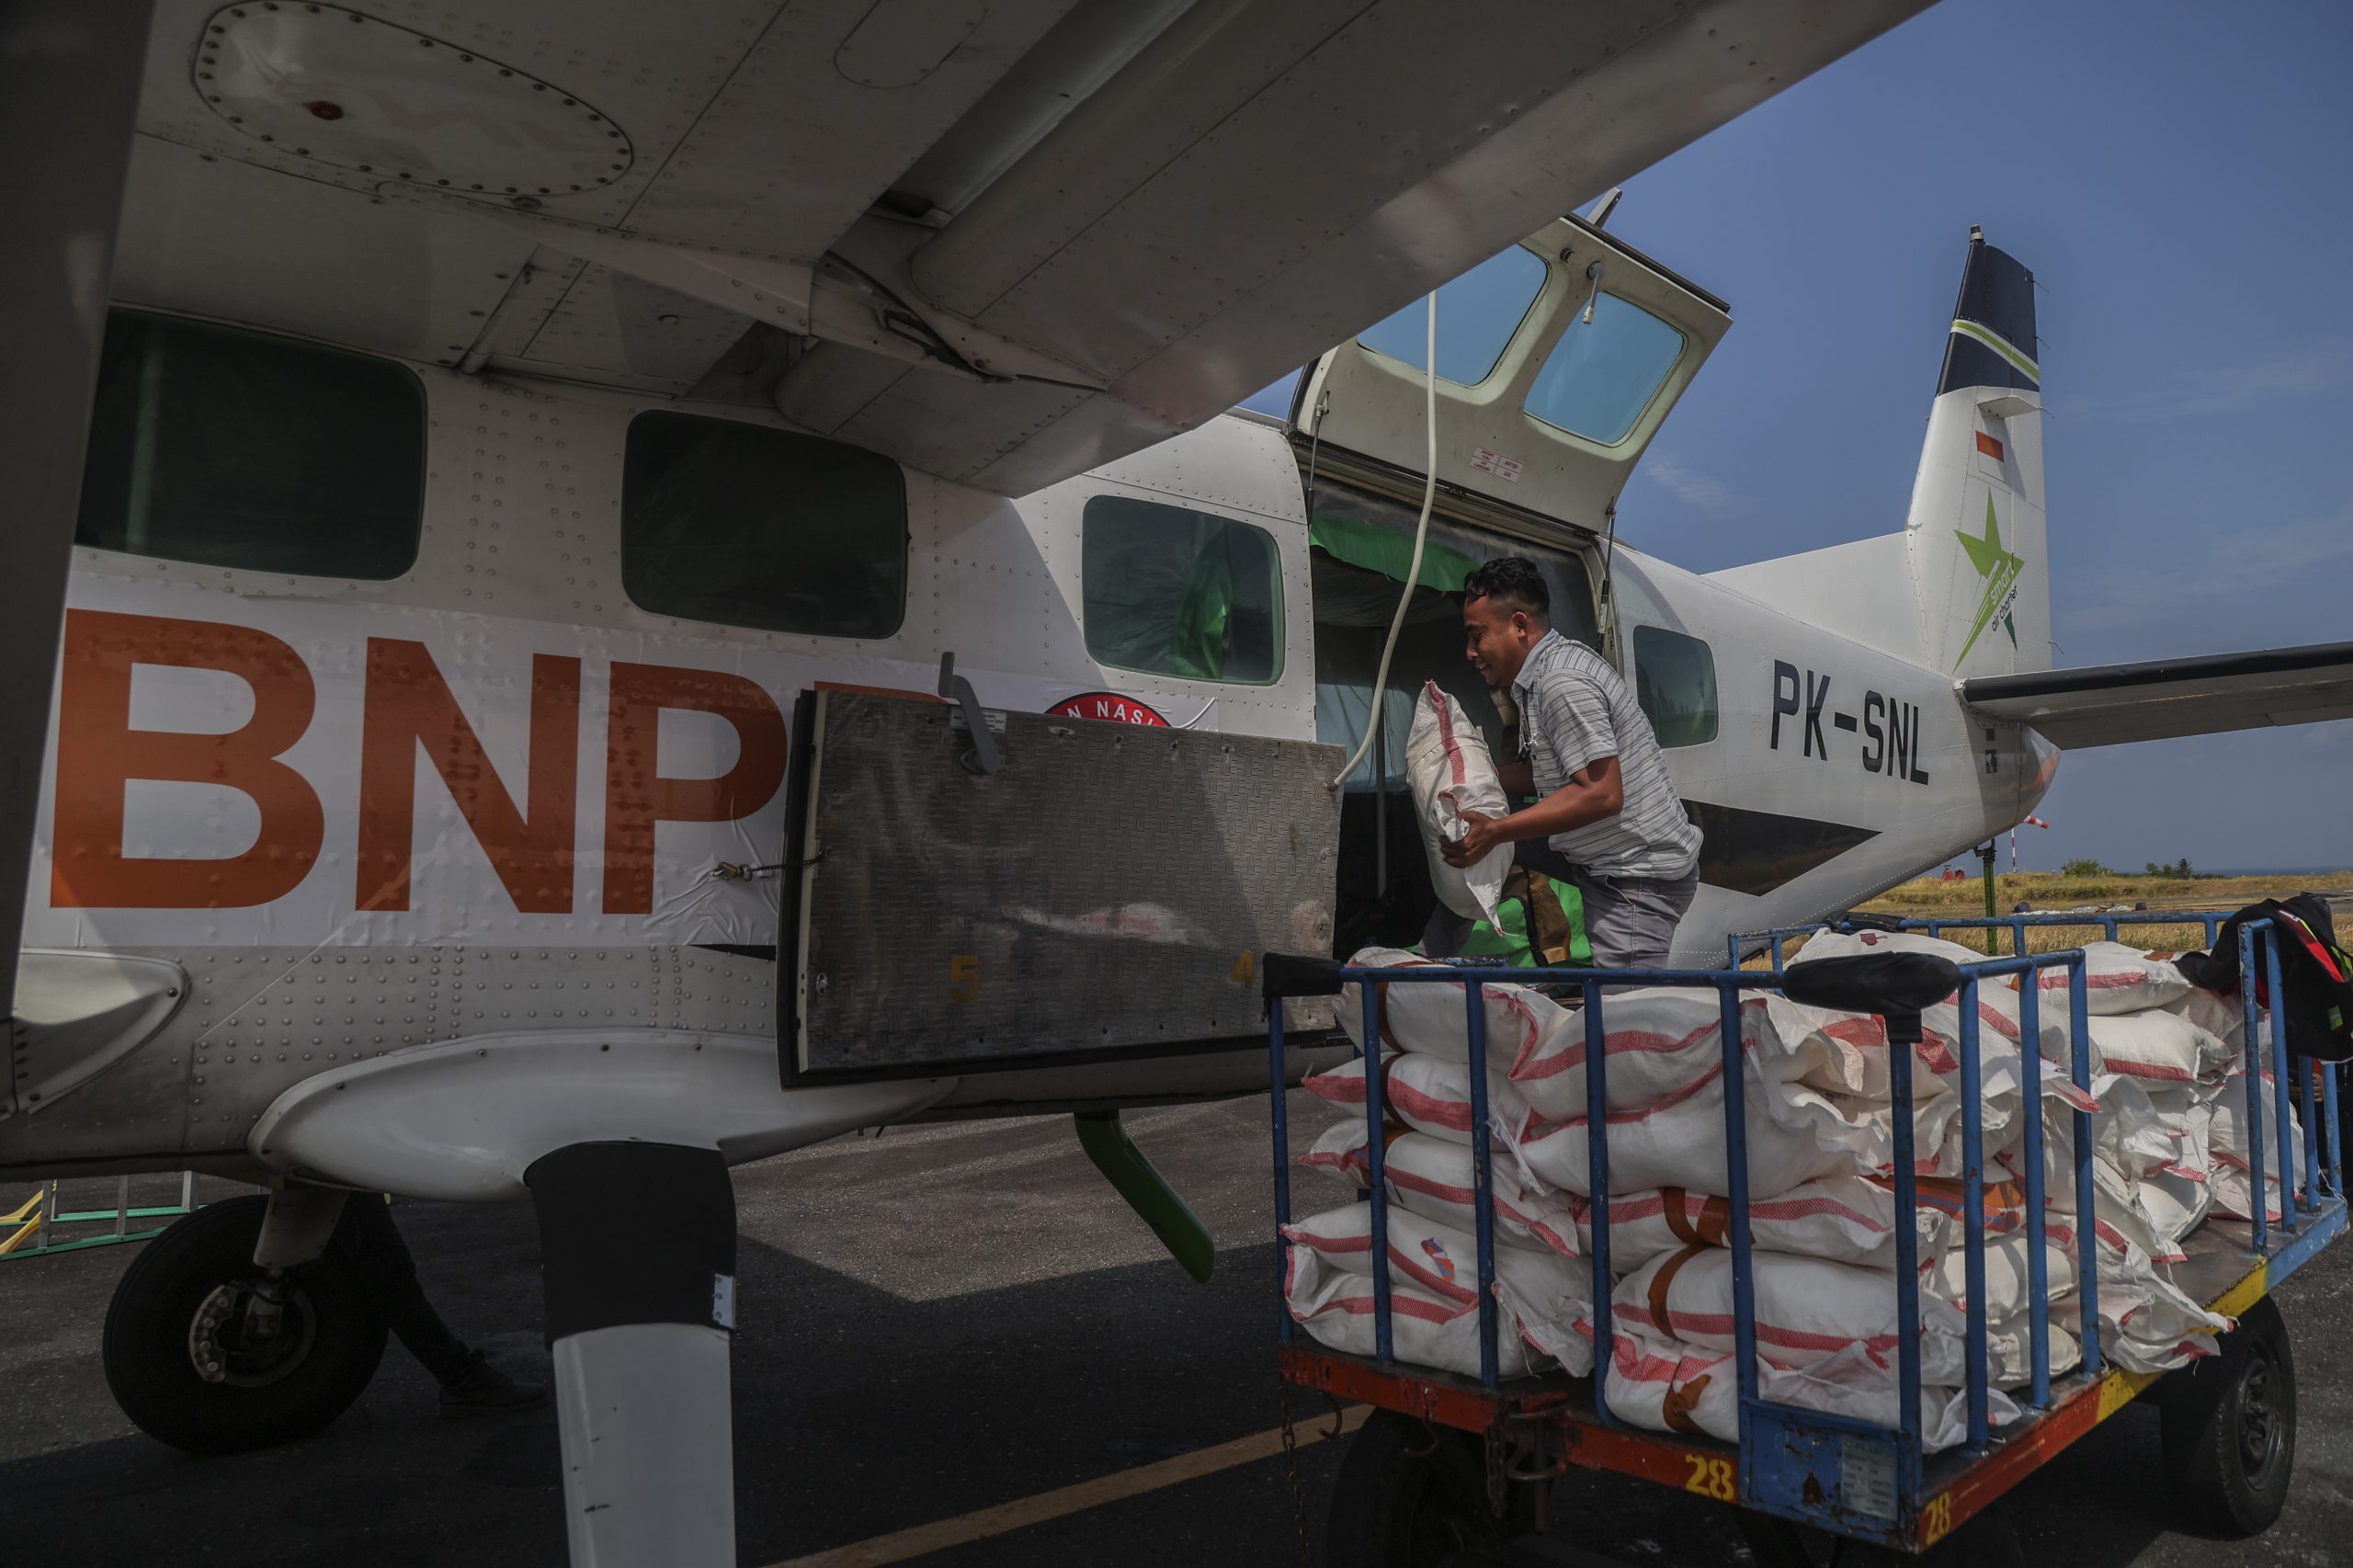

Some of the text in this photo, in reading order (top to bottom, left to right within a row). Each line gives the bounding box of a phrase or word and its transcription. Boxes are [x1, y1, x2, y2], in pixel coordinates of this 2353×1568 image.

[1770, 659, 1928, 786] PK-SNL
[51, 608, 948, 915] BNP
[948, 954, 983, 1004] 5
[1686, 1454, 1735, 1502] 28
[1925, 1490, 1952, 1546] 28
